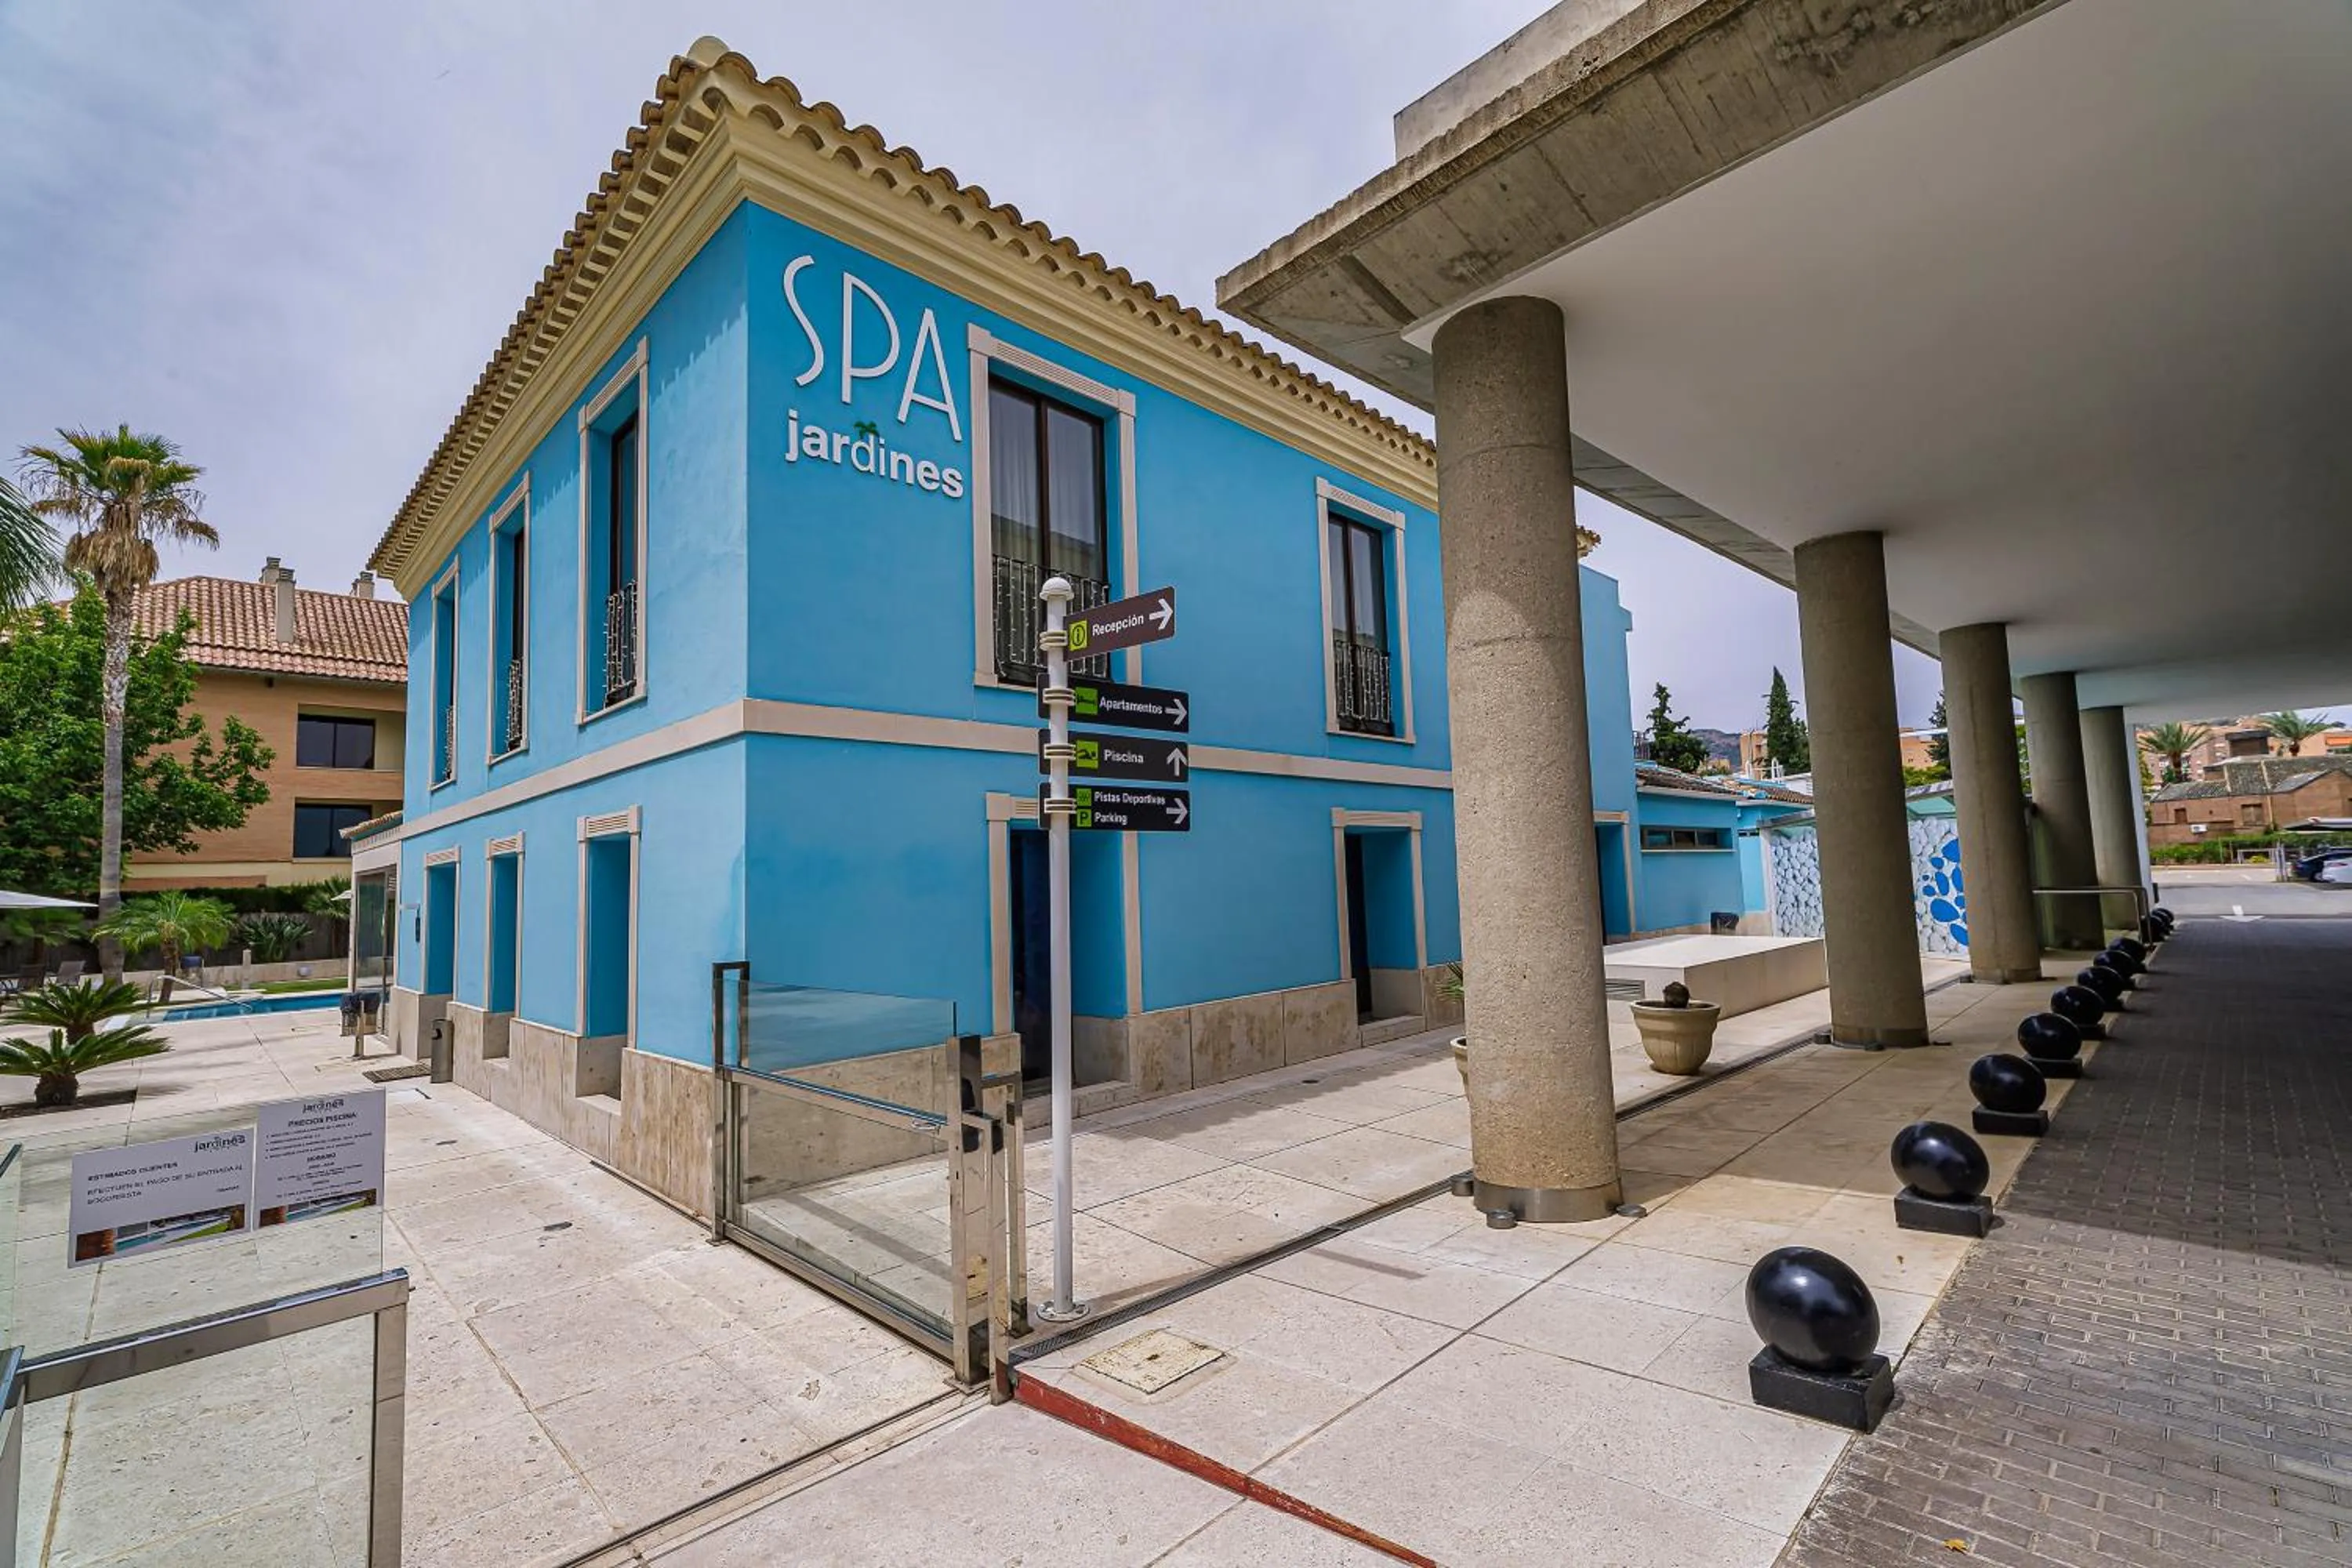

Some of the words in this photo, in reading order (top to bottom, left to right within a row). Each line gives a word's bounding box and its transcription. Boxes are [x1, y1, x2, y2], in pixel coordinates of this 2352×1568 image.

[783, 254, 963, 442] SPA
[785, 408, 964, 499] jardines
[1092, 614, 1144, 637] Recepción
[1099, 696, 1163, 715] Apartamentos
[1104, 749, 1144, 764] Piscina
[1094, 792, 1120, 802] Pistas
[1123, 793, 1166, 805] Deportivas
[1094, 812, 1127, 826] Parking
[325, 1112, 357, 1123] PISCINA
[194, 1134, 246, 1152] jardines
